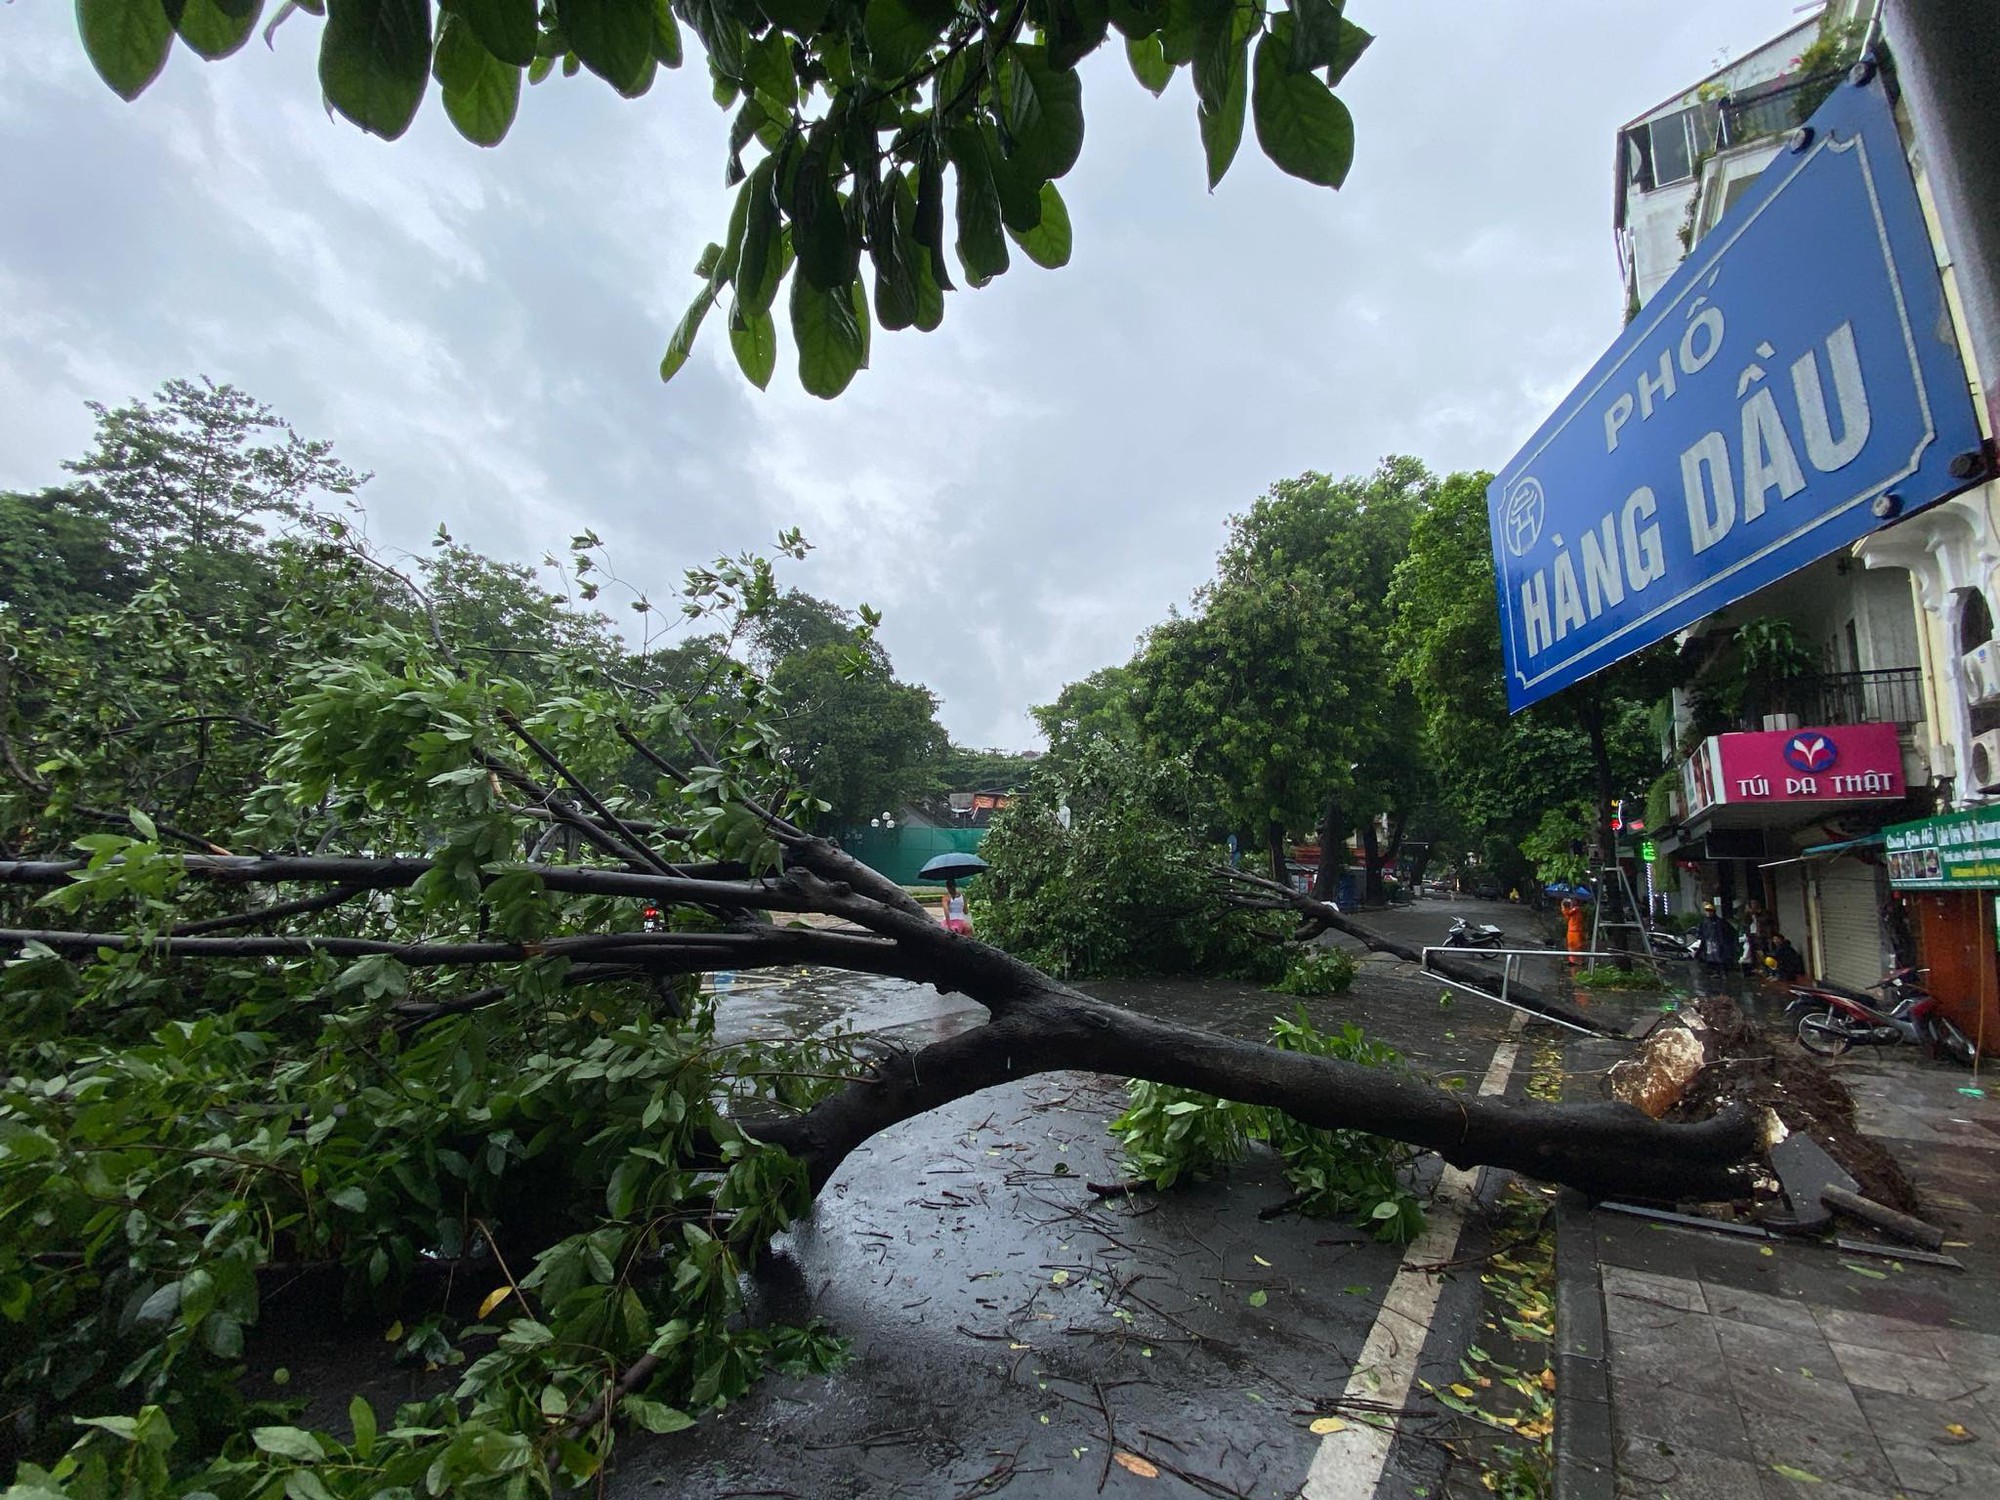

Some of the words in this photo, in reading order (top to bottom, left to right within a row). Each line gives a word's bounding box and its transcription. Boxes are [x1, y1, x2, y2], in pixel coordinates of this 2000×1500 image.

[1603, 266, 1725, 454] PHỐ
[1520, 485, 1665, 658] HÀNG
[1680, 320, 1871, 556] DẦU
[1736, 774, 1770, 797] TÚI
[1785, 777, 1817, 795] DA
[1830, 769, 1893, 795] THẬT
